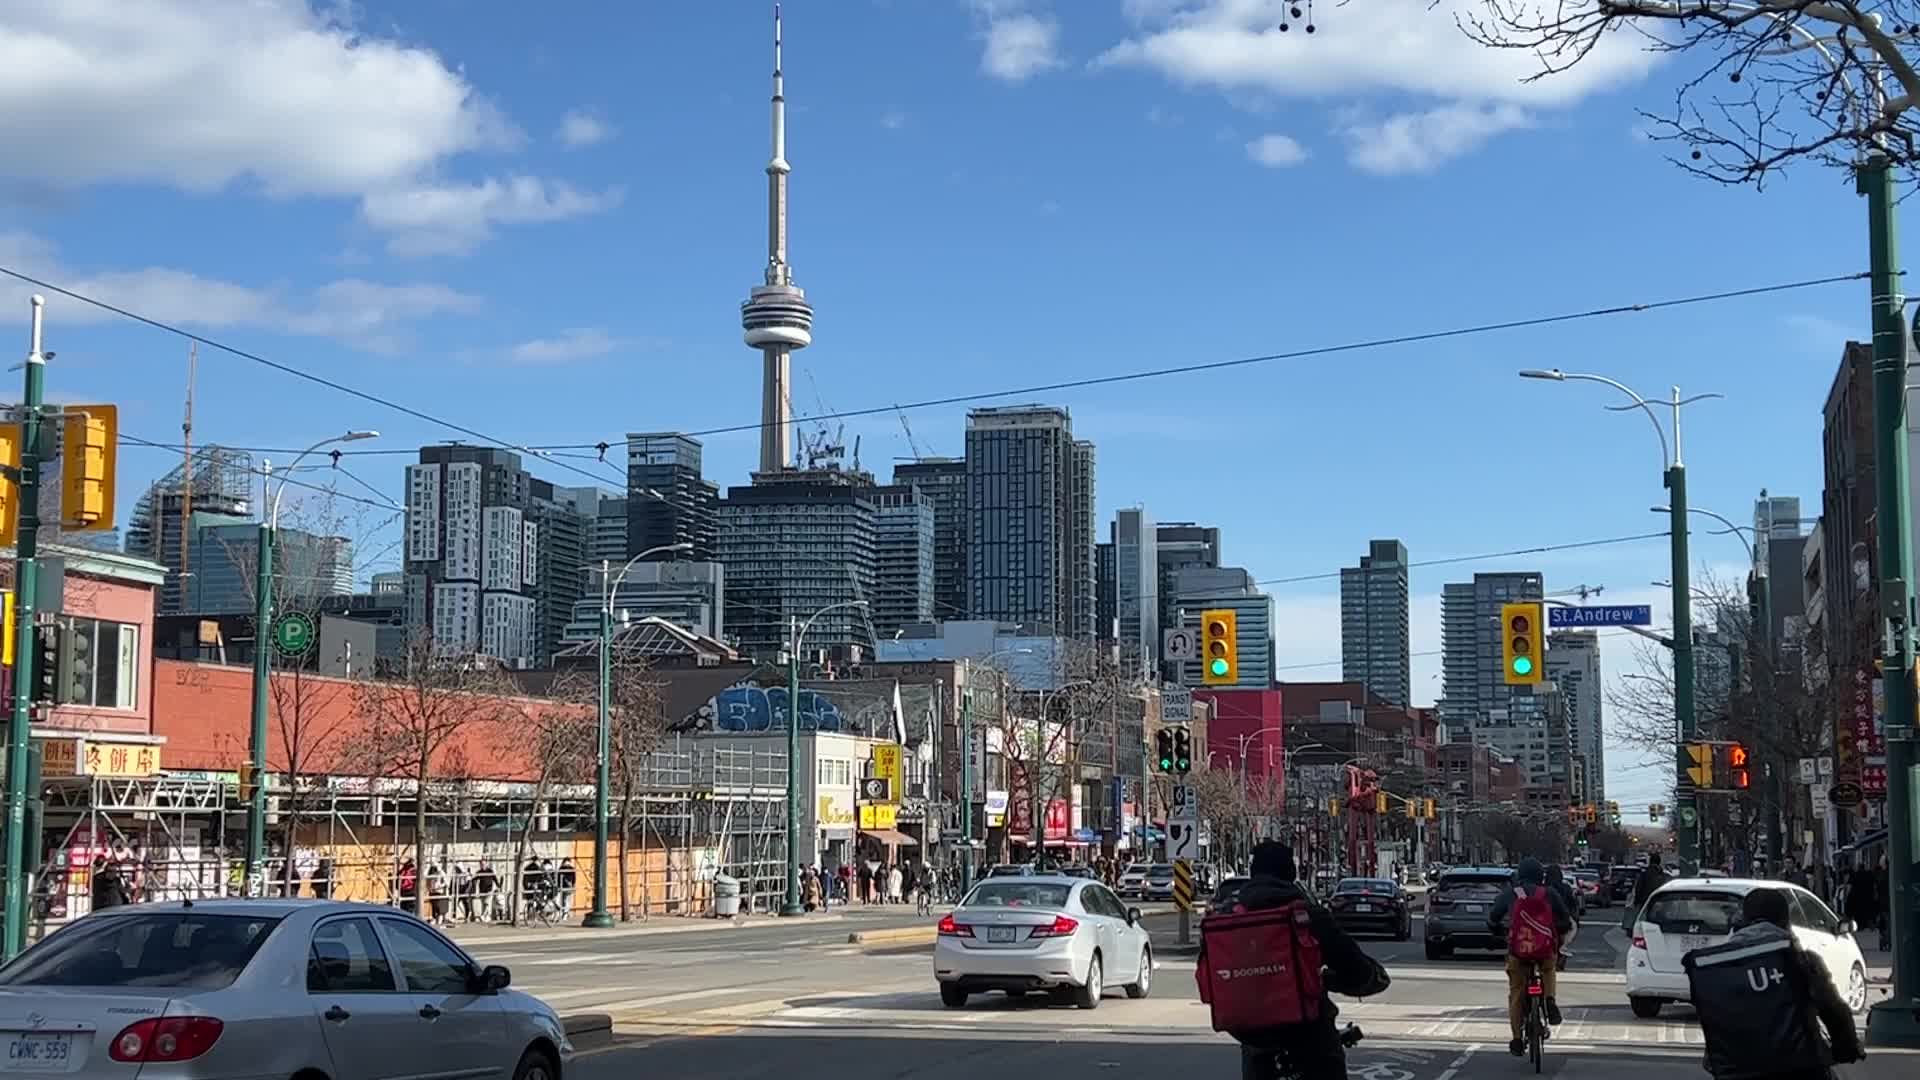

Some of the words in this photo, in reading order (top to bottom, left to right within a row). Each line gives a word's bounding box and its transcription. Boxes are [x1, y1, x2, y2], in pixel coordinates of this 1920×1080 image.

[286, 623, 302, 641] P
[1163, 693, 1190, 705] TRANSIT
[1164, 706, 1189, 718] SIGNAL
[1233, 964, 1287, 978] DOORDASH
[1747, 966, 1785, 991] U+
